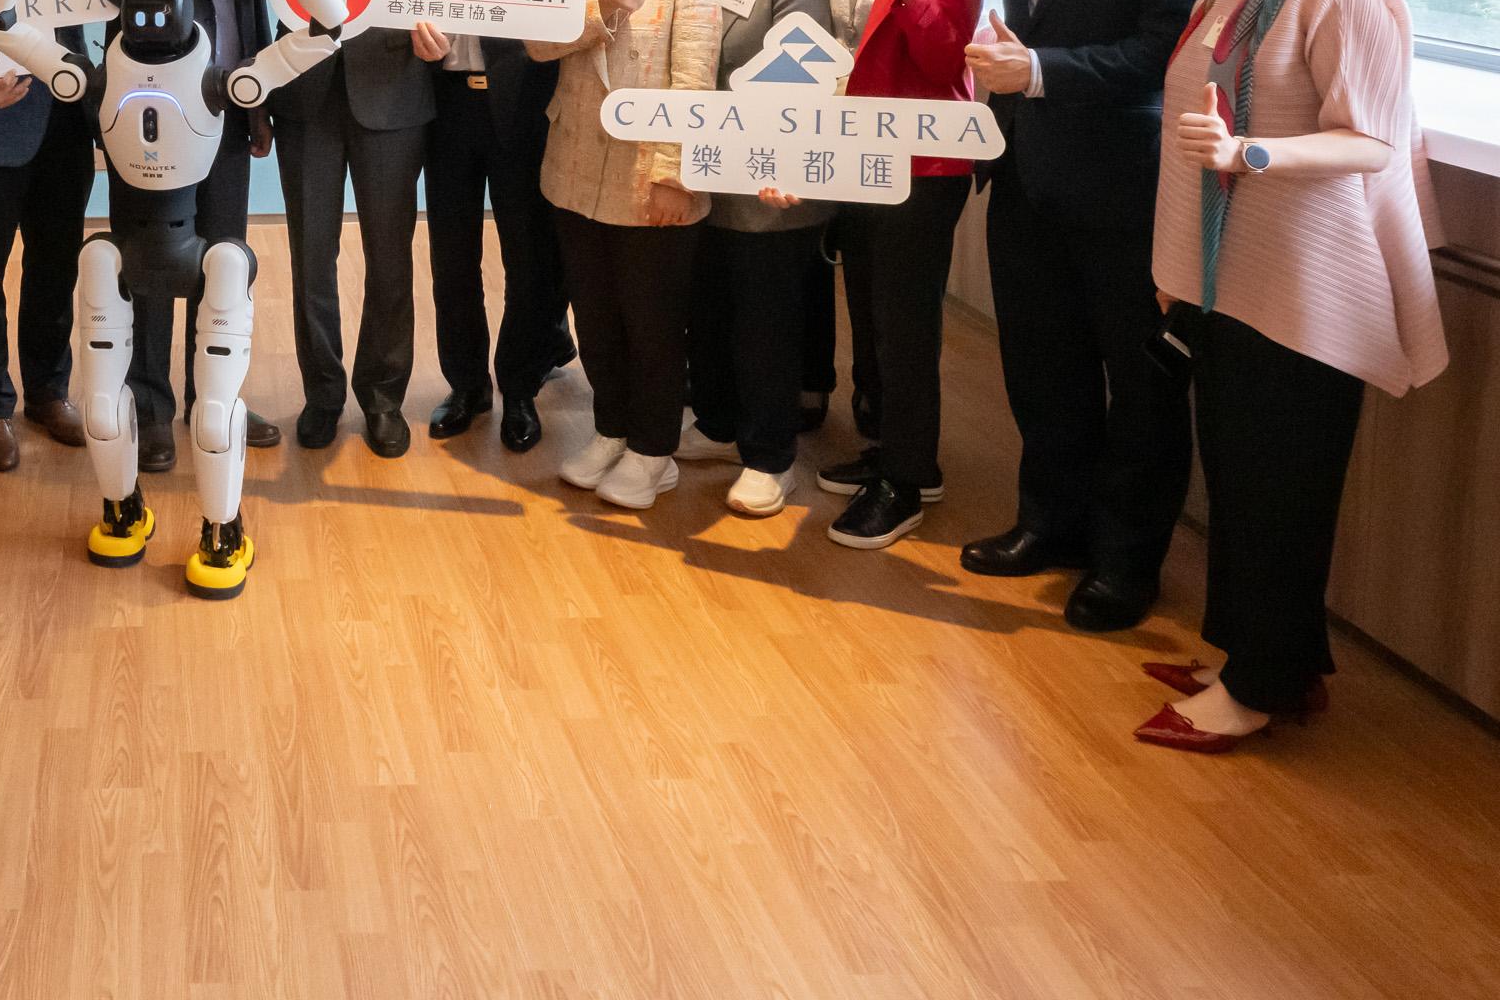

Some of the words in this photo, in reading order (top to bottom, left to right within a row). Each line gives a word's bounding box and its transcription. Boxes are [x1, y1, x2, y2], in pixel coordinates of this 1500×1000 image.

[614, 101, 745, 131] CASA
[780, 107, 987, 144] SIERRA
[129, 162, 177, 171] NOVAUTEK
[691, 144, 894, 189] 樂嶺都匯
